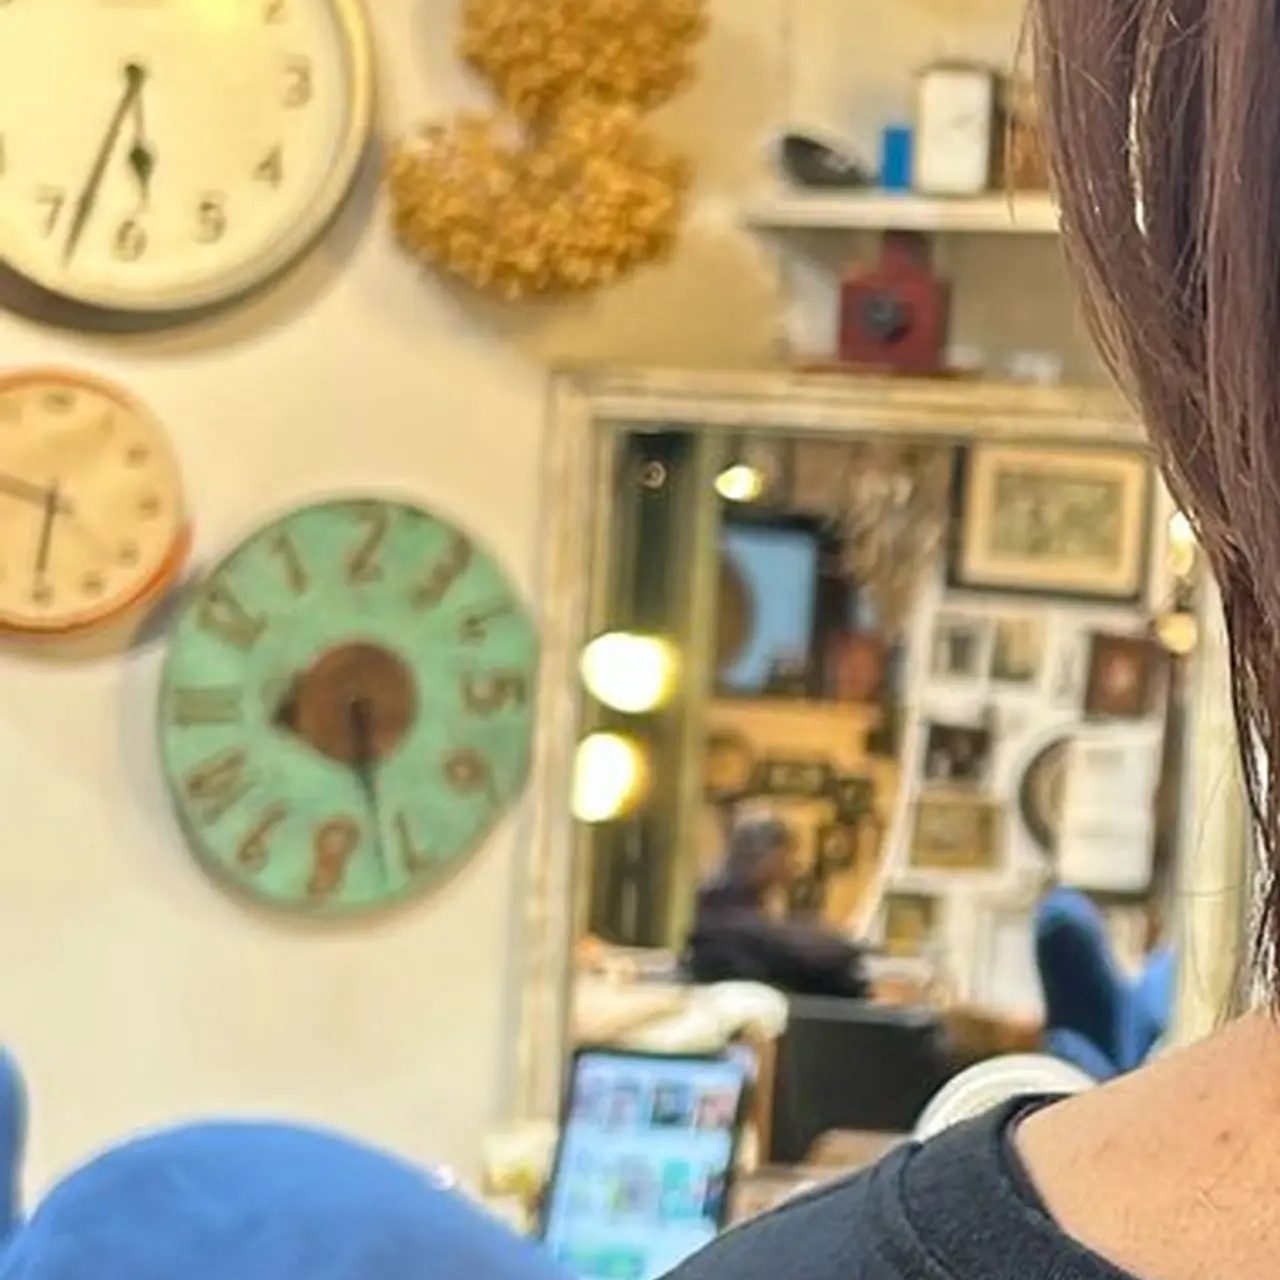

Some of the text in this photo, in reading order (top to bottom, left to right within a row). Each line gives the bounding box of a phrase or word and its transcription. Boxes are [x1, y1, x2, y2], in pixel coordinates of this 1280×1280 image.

[283, 60, 312, 110] 3
[255, 147, 282, 189] 4
[35, 192, 65, 238] 7
[197, 197, 226, 244] 5
[115, 219, 146, 262] 6
[270, 530, 308, 594] 1
[349, 507, 388, 582] 2
[462, 673, 528, 714] 5
